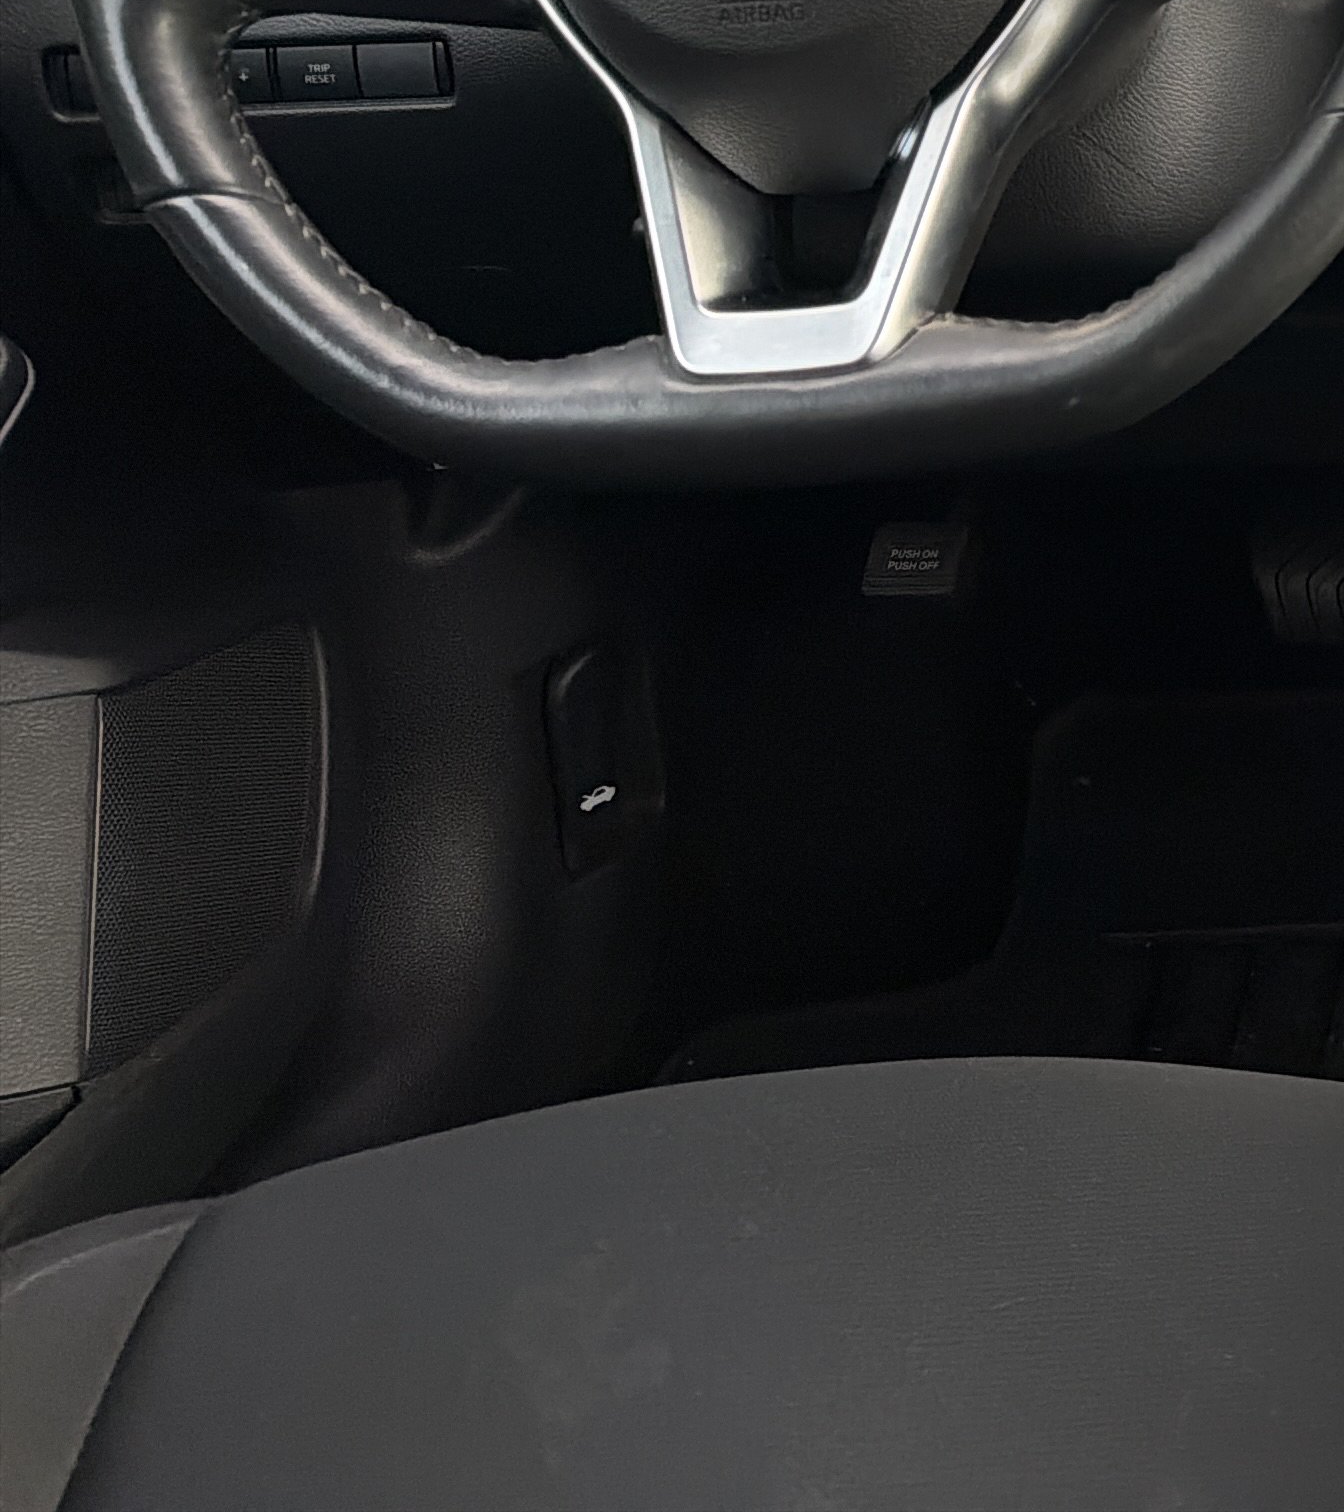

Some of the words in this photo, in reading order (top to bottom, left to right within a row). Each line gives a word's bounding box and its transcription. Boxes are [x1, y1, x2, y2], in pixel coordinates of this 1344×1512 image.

[307, 63, 330, 73] TRIP
[304, 74, 336, 84] RESET
[890, 549, 921, 559] PUSH
[922, 549, 939, 559] ON
[887, 561, 917, 571] PUSH
[918, 560, 941, 570] OFF
